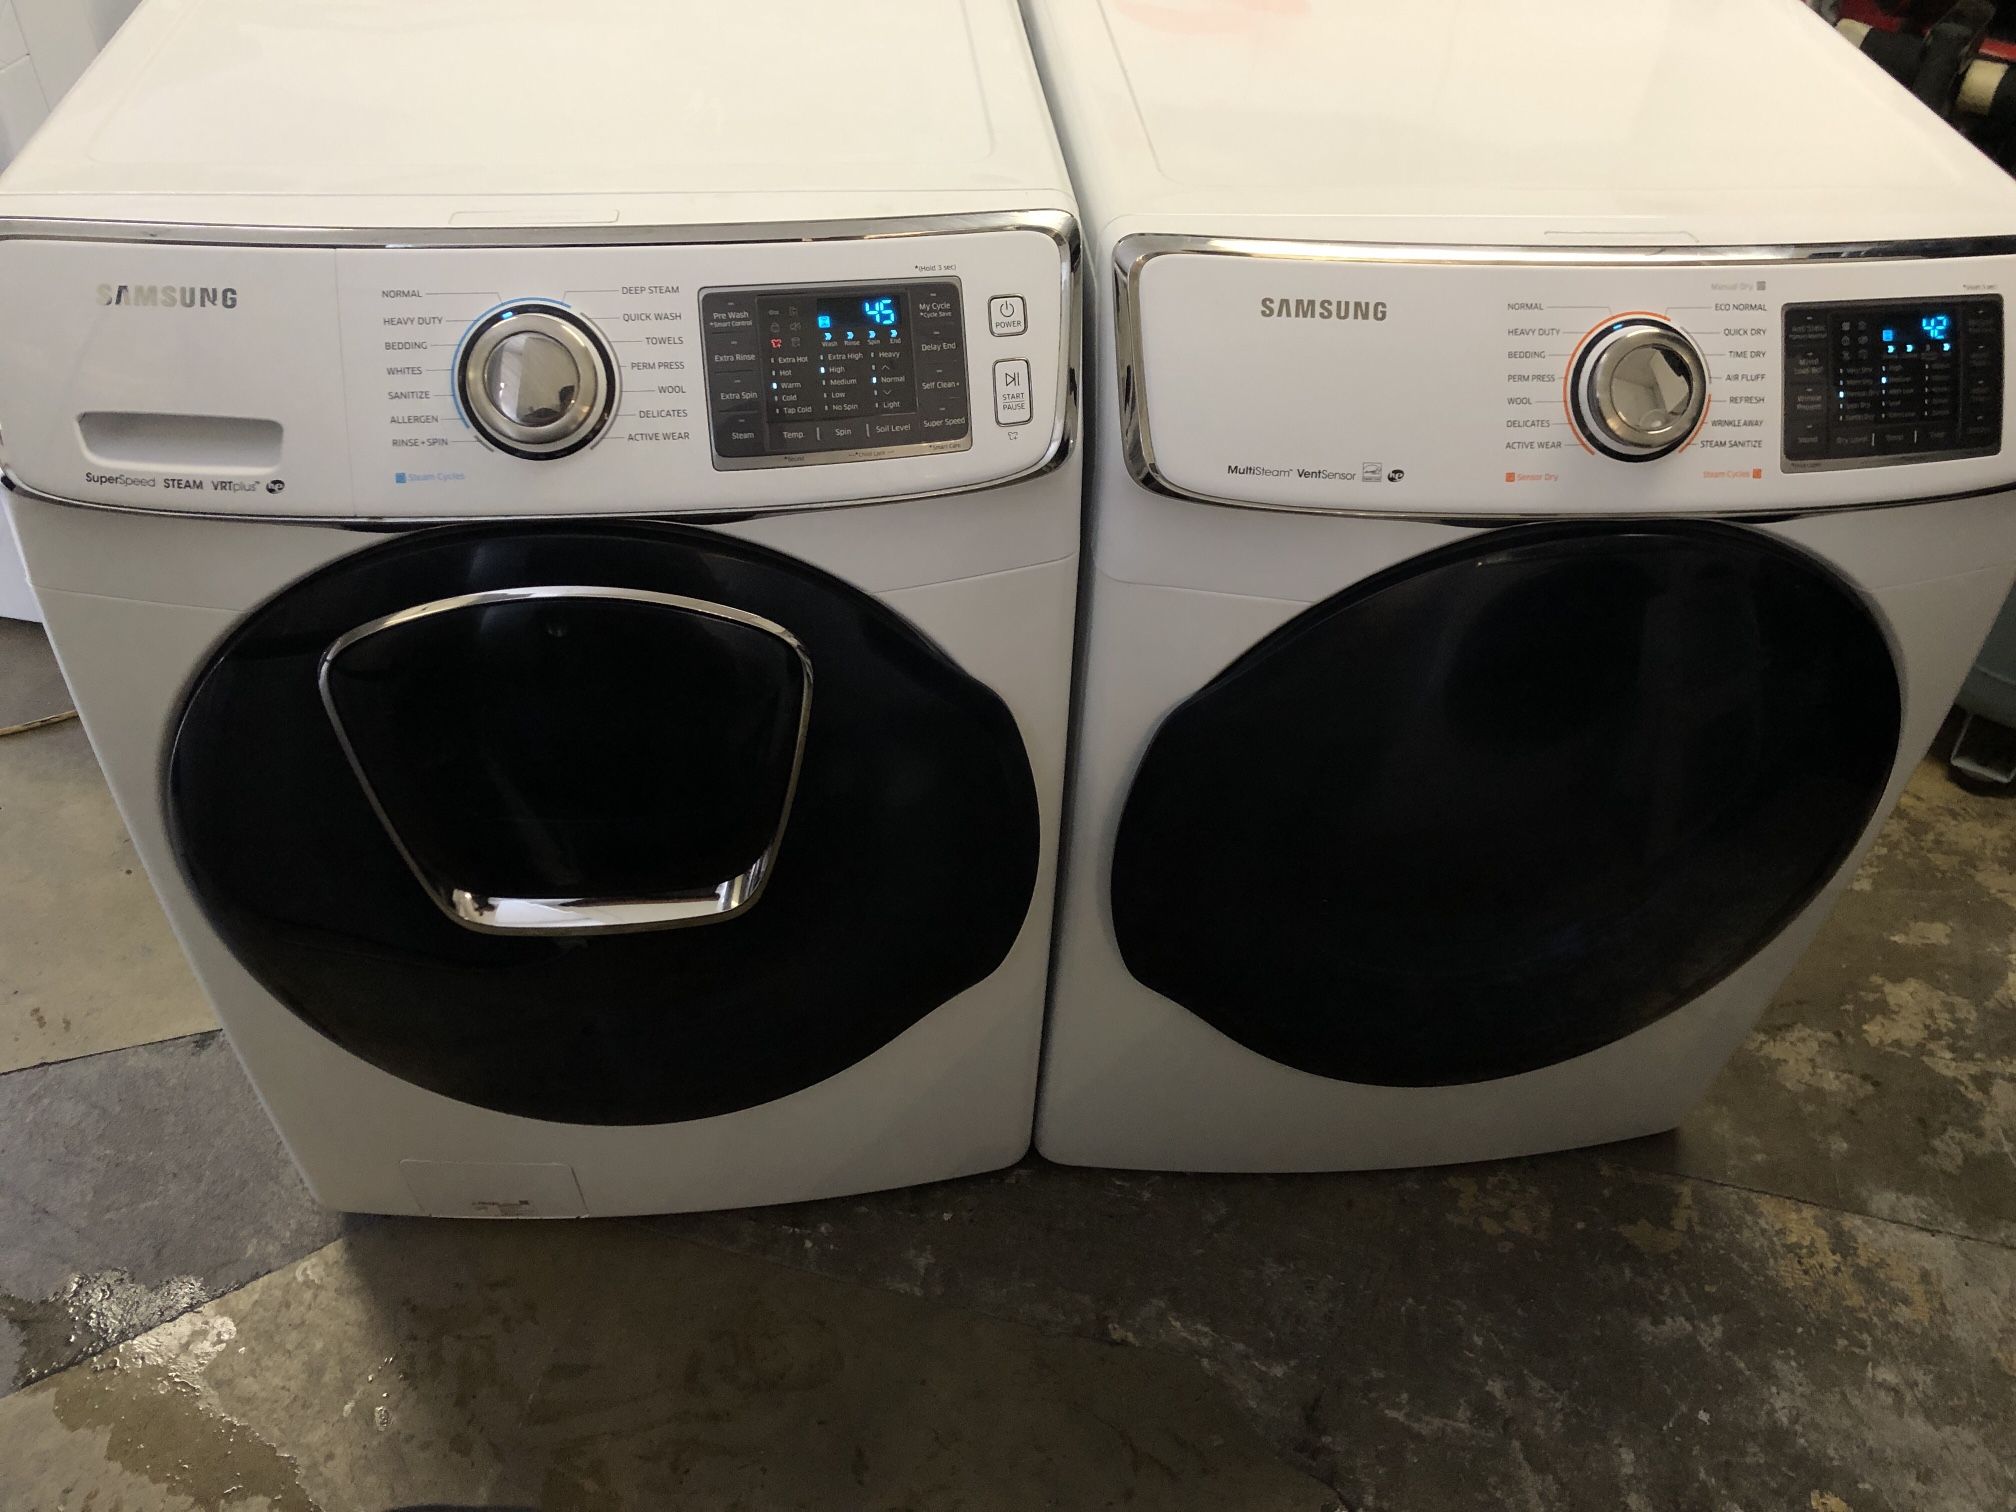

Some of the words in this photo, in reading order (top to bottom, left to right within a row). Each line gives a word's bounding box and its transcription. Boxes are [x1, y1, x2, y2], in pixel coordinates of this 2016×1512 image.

[381, 290, 422, 298] NORMAL
[621, 286, 646, 295] DEEP
[648, 286, 680, 294] STEAM
[96, 283, 238, 309] SAMSUNG
[919, 303, 930, 312] My
[931, 301, 951, 310] Cycle
[1260, 297, 1388, 322] SAMSUNG
[1507, 302, 1544, 311] NORMAL
[1714, 303, 1730, 312] ECO
[1732, 303, 1767, 312] NORMAL
[728, 310, 749, 319] Wash
[864, 298, 895, 325] 45
[383, 317, 415, 326] HEAVY
[417, 316, 443, 325] DUTY
[622, 313, 652, 322] QUICK
[653, 312, 682, 321] WASH
[995, 320, 1022, 329] POWER
[1922, 316, 1948, 340] 42
[1507, 328, 1536, 336] HEAVY
[1538, 328, 1560, 336] DUTY
[1723, 328, 1748, 336] QUICK
[645, 336, 684, 345] TOWELS
[384, 342, 428, 350] BEDDING
[921, 343, 941, 352] Delay
[1507, 350, 1546, 359] BEDDING
[1728, 350, 1748, 358] TIME
[1750, 350, 1766, 358] DRY
[631, 362, 656, 371] PERM
[658, 361, 685, 370] PRESS
[386, 367, 423, 375] WHITES
[1507, 374, 1530, 382] PERM
[1531, 374, 1556, 382] PRESS
[1741, 373, 1766, 381] FLUFF
[658, 385, 686, 394] WOOL
[922, 381, 935, 390] Self
[388, 391, 430, 400] SANITIZE
[741, 391, 758, 400] Spin
[1002, 392, 1024, 400] START
[1729, 396, 1765, 404] REFRESH
[1002, 402, 1025, 410] PAUSE
[1507, 397, 1532, 406] WOOL
[639, 409, 688, 419] DELICATES
[783, 407, 796, 415] Tap
[390, 415, 439, 424] ALLERGEN
[945, 417, 965, 426] Speed
[1506, 419, 1550, 428] DELICATES
[732, 432, 755, 440] Steam
[782, 431, 804, 439] Temp
[835, 428, 852, 436] Spin
[627, 432, 660, 442] ACTIVE
[662, 432, 690, 441] WEAR
[1505, 441, 1535, 450] ACTIVE
[1537, 441, 1562, 449] WEAR
[1700, 440, 1726, 448] STEAM
[1728, 440, 1763, 448] SANITIZE
[1297, 468, 1356, 481] VentSensor
[1544, 473, 1559, 481] Dry
[85, 472, 156, 488] SuperSpeed
[163, 478, 204, 490] STEAM
